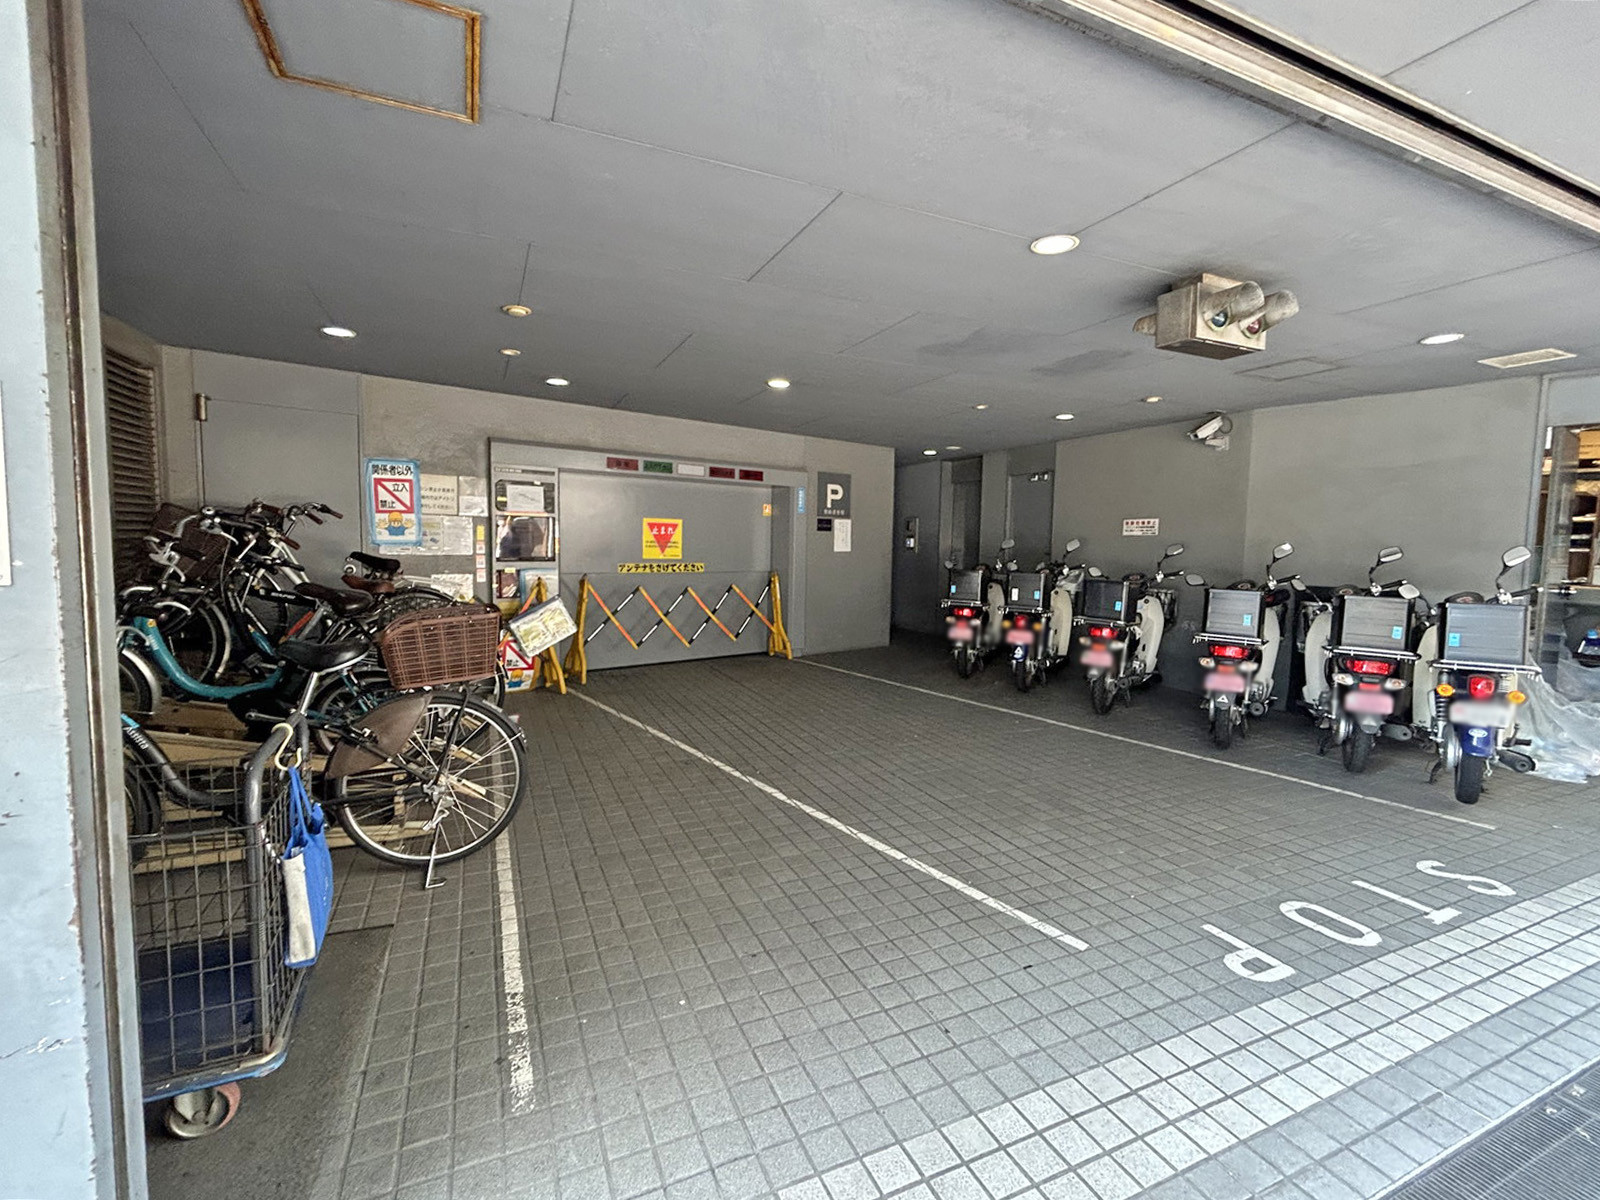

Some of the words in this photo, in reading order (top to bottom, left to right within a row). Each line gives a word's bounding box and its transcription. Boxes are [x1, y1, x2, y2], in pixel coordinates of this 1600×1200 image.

[371, 463, 414, 476] 関係者以外
[391, 483, 409, 493] 立入
[826, 483, 844, 509] P
[379, 499, 396, 509] 禁止
[651, 525, 676, 535] 止まれ
[618, 563, 704, 573] アンテナをさげてください
[122, 726, 150, 750] Assista
[1200, 859, 1517, 983] STOP
